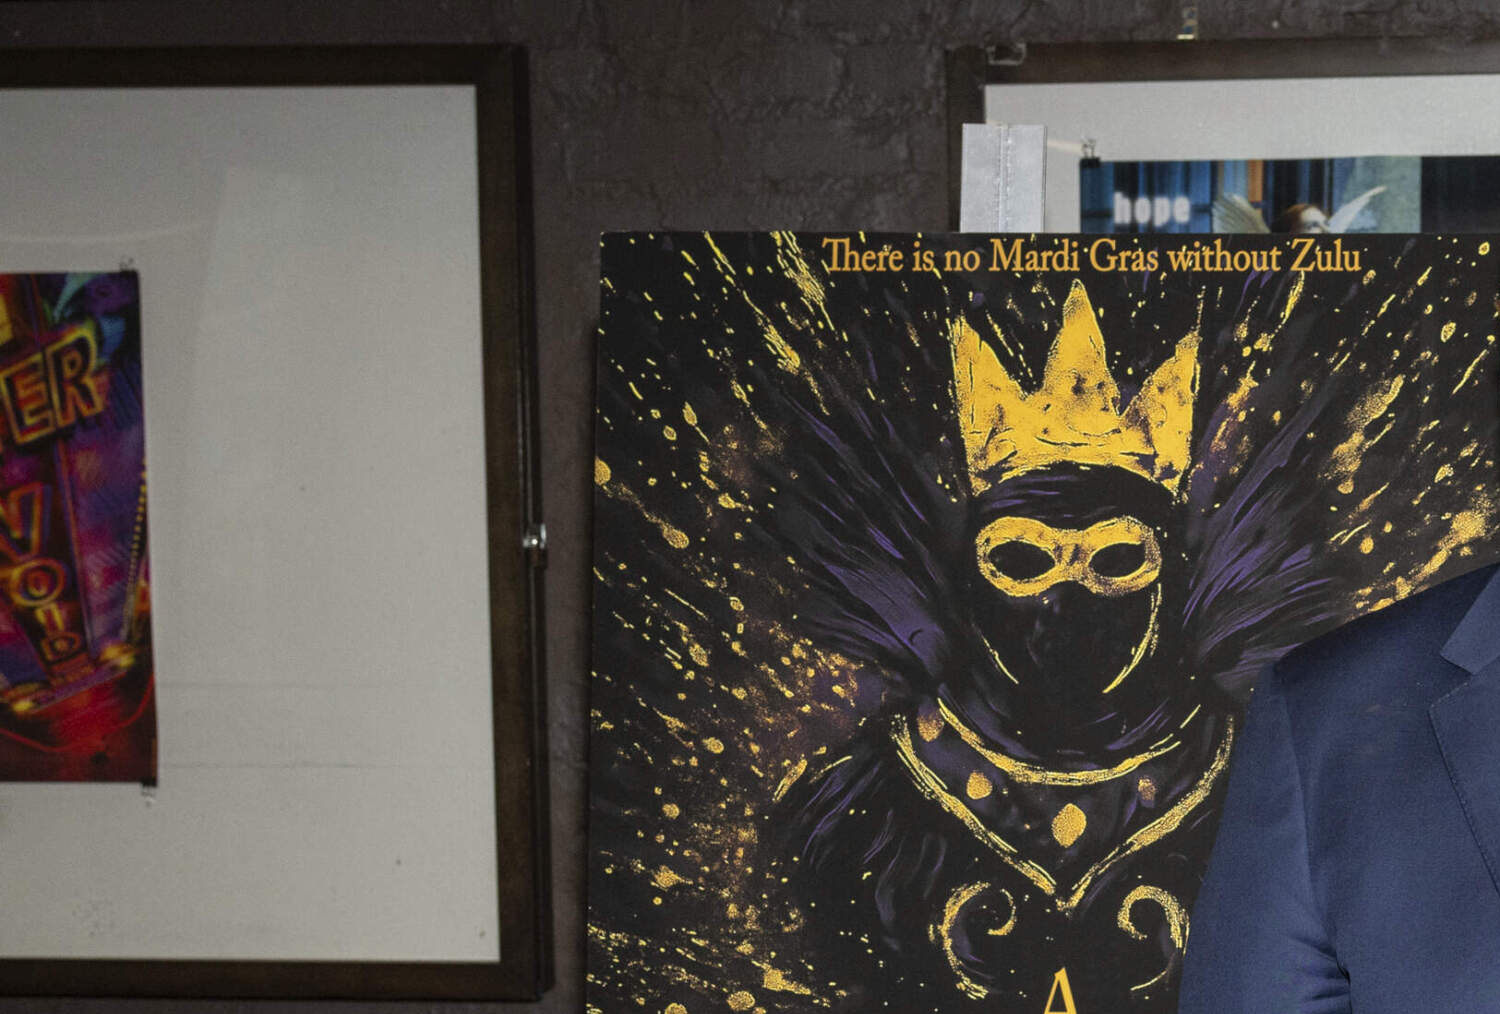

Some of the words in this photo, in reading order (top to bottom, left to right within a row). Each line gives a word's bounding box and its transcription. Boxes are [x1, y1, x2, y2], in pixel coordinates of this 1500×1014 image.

[1113, 191, 1190, 227] hope
[821, 237, 904, 272] There
[912, 240, 935, 272] is
[943, 249, 981, 272] no
[988, 238, 1081, 272] Mardi
[1089, 238, 1159, 272] Gras
[1167, 238, 1282, 272] without
[1290, 238, 1361, 272] Zulu
